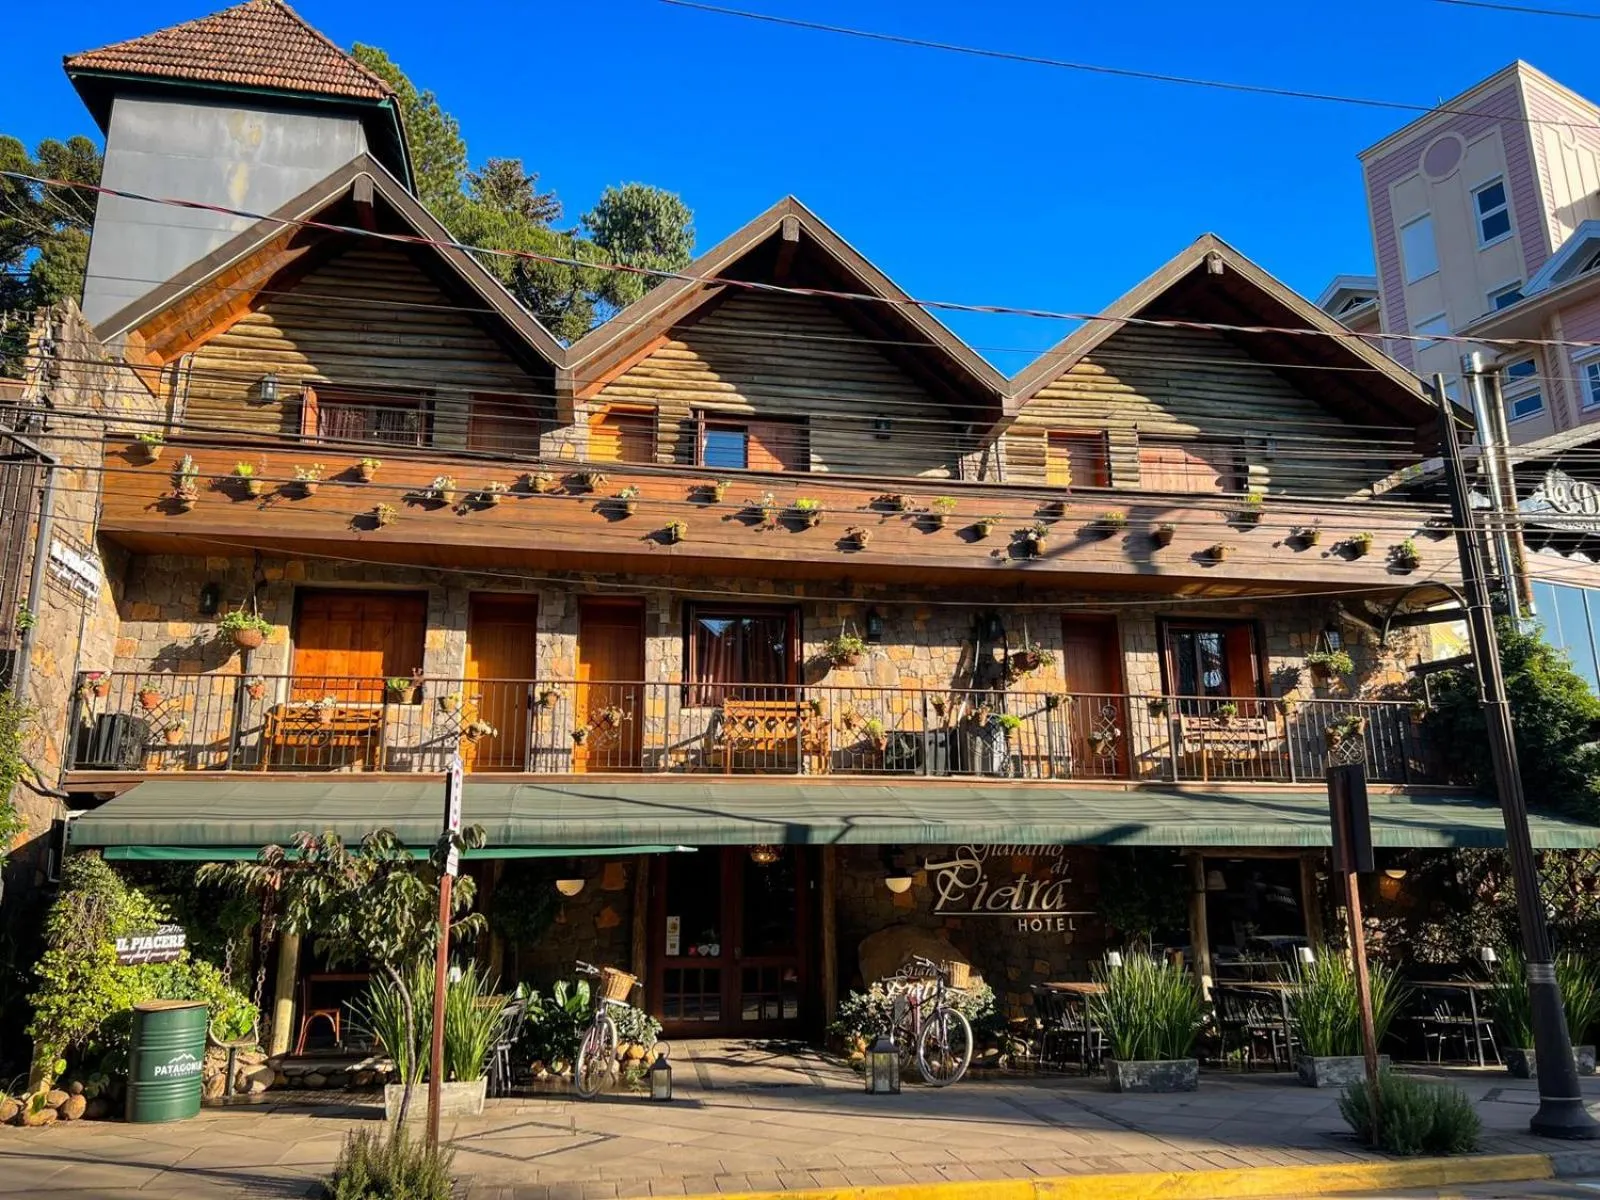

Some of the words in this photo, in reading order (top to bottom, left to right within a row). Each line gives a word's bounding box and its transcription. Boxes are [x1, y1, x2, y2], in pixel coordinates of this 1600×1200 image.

[1051, 855, 1070, 876] di
[924, 857, 1072, 911] Pietra
[1018, 918, 1077, 932] HOTEL
[130, 934, 186, 950] PIACERE
